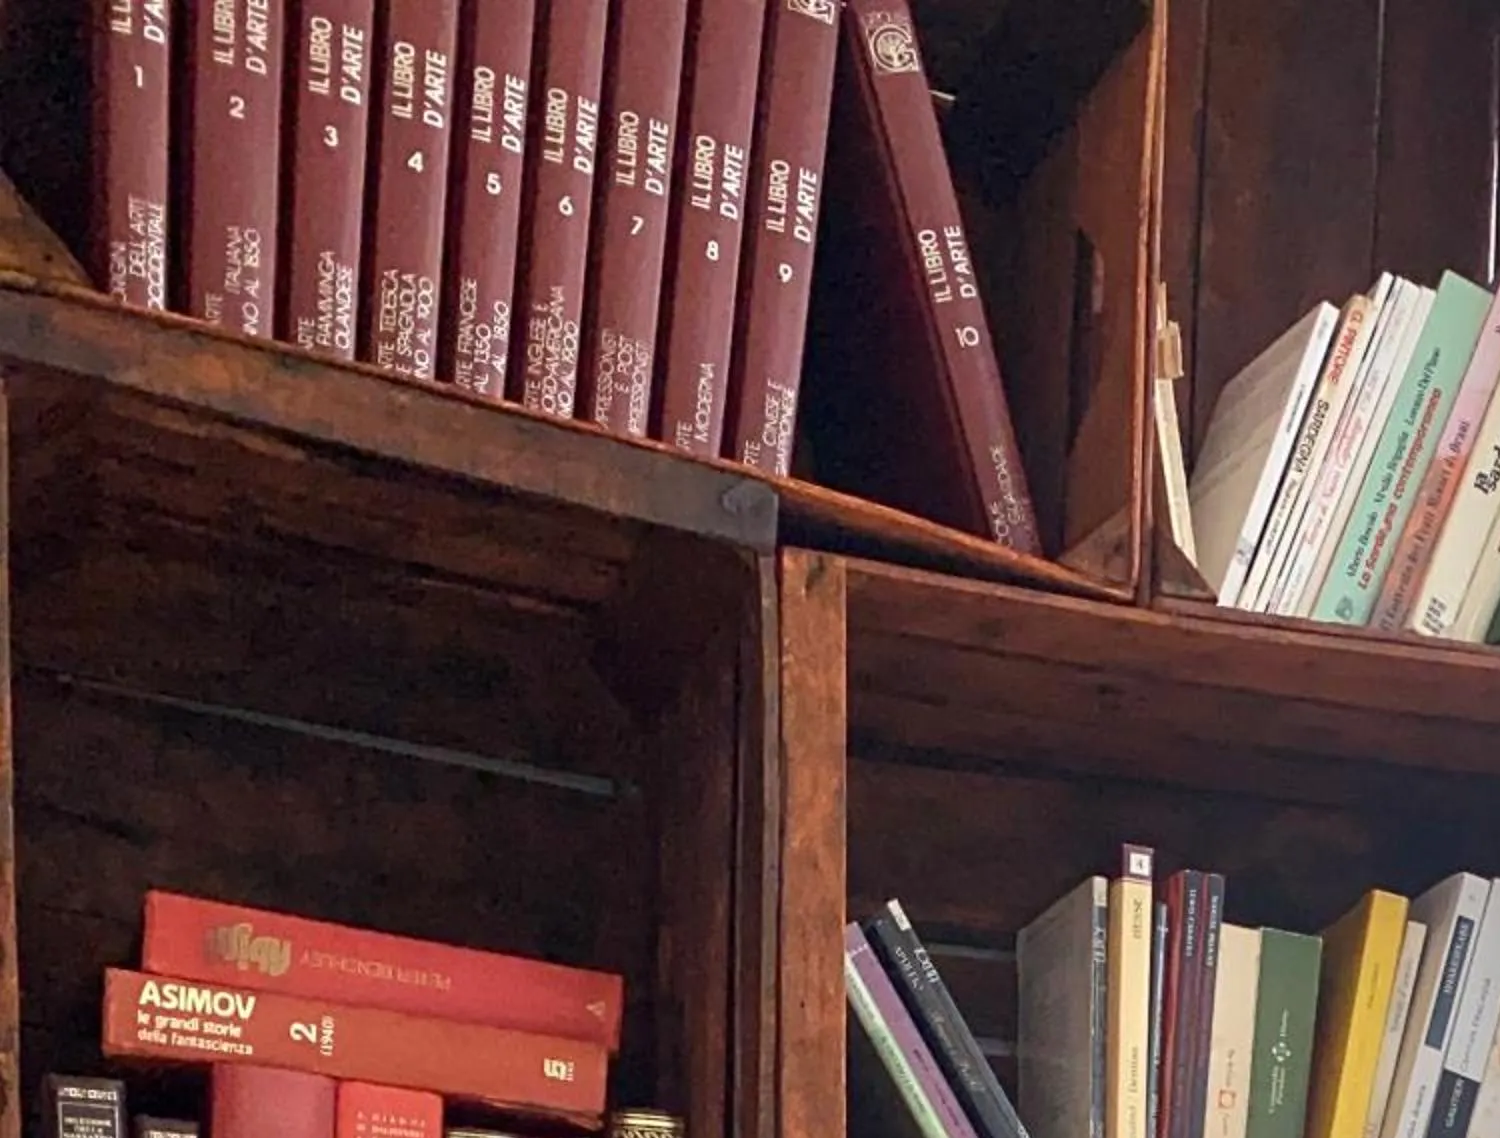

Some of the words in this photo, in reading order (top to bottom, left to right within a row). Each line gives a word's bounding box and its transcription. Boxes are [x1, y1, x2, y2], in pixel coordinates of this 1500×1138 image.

[213, 0, 235, 45] LIBR
[309, 16, 332, 74] LIBRO
[213, 49, 234, 65] IL
[340, 24, 364, 105] D'ARTE
[134, 65, 143, 88] 1
[392, 41, 415, 98] LIBRO
[308, 77, 330, 95] IL
[423, 50, 447, 129] D'ARTE
[472, 66, 495, 126] LIBRO
[229, 96, 245, 119] 2
[392, 103, 412, 119] IL
[501, 74, 525, 153] D'ARTE
[546, 88, 568, 145] LIBRO
[324, 126, 339, 147] 3
[471, 130, 491, 143] IL
[574, 96, 598, 175] D'ARTE
[616, 111, 639, 168] LIBRO
[408, 152, 423, 173] 4
[544, 148, 563, 164] IL
[645, 118, 669, 196] D'ARTE
[693, 135, 716, 193] LIBRO
[486, 173, 502, 195] 5
[616, 171, 635, 185] IL
[720, 144, 743, 220] D'ARTE
[767, 159, 790, 216] LIBRO
[559, 196, 574, 216] 6
[691, 195, 711, 210] IL
[794, 167, 817, 243] D'ARTE
[631, 216, 644, 235] 7
[766, 218, 785, 233] IL
[706, 240, 720, 261] 8
[918, 229, 949, 287] LIBRO
[944, 226, 977, 298] D'ARTE
[779, 263, 792, 283] 9
[243, 278, 260, 299] AL
[934, 288, 953, 303] IL
[416, 328, 431, 345] AL
[956, 326, 979, 348] 10
[1294, 399, 1330, 474] SARDEGNA
[1135, 858, 1146, 870] 4
[138, 979, 256, 1020] ASIMOV
[137, 1009, 151, 1024] le
[155, 1013, 200, 1032] grandi
[203, 1020, 242, 1038] storie
[290, 1021, 318, 1044] 2
[137, 1028, 167, 1045] della
[171, 1031, 254, 1055] fantascienza
